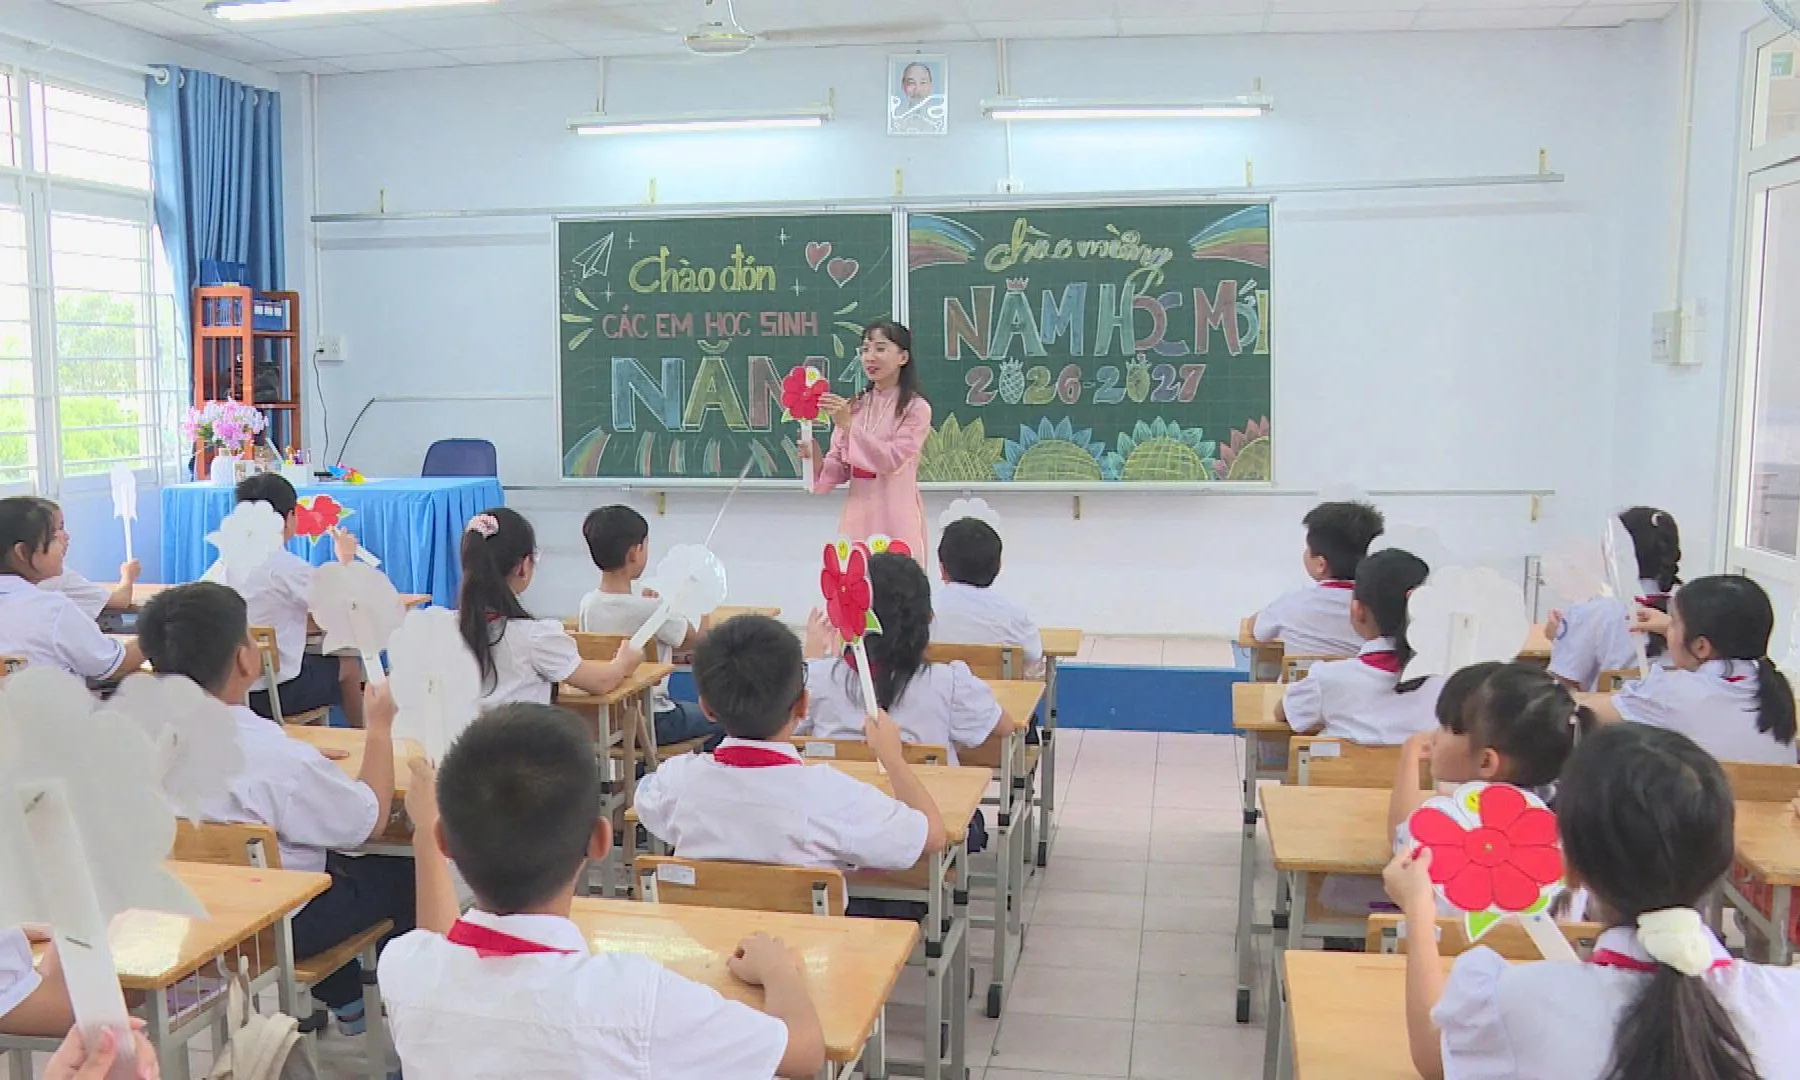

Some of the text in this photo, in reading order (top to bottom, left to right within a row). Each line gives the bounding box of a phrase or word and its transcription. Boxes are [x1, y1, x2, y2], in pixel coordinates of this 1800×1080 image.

[628, 243, 777, 293] Chào đón
[602, 304, 649, 338] CÁC
[655, 313, 693, 338] EM
[760, 311, 818, 337] SINH
[964, 358, 1206, 405] 2026-2027
